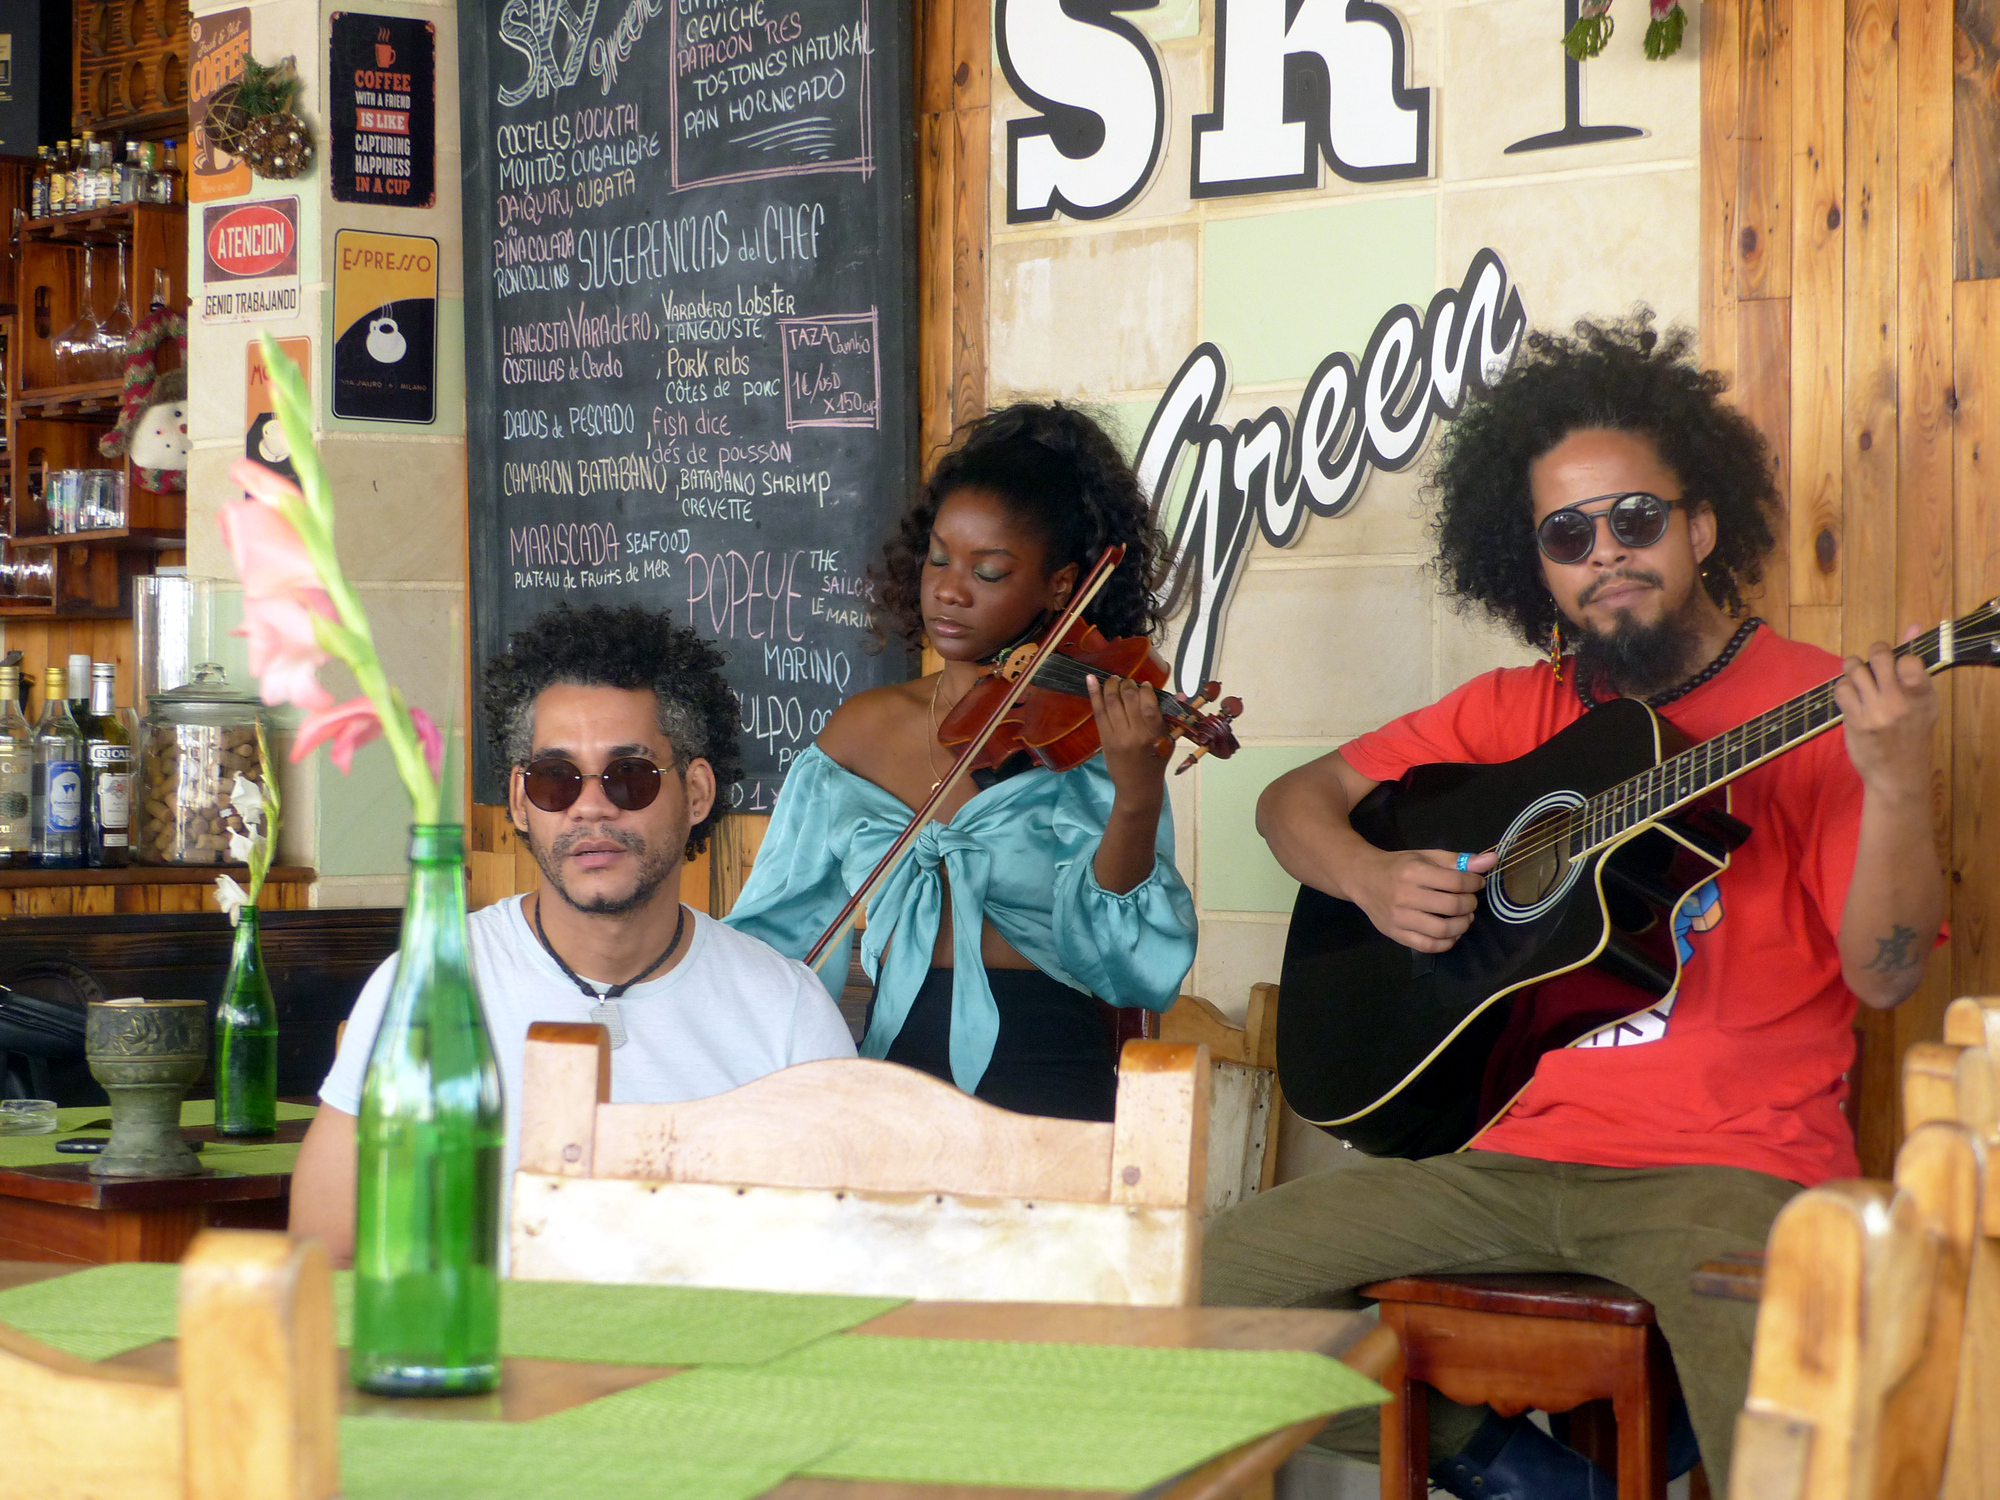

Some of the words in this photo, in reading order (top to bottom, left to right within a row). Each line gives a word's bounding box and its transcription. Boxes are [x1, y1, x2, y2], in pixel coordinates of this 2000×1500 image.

[686, 0, 768, 43] CEVICHE
[677, 30, 753, 77] PATACON
[764, 11, 803, 45] RES
[693, 49, 788, 101] TOSTONES
[792, 20, 875, 68] NATURAL
[354, 69, 411, 92] COFFEE
[355, 90, 376, 106] WITH
[377, 92, 383, 107] A
[385, 93, 411, 109] FRIEND
[683, 105, 720, 139] PAN
[728, 68, 846, 124] HORNEADO
[361, 112, 374, 128] IS
[376, 113, 405, 130] LIKE
[355, 133, 411, 156] CAPTURING
[355, 154, 411, 177] HAPPINESS
[355, 175, 370, 192] IN
[373, 177, 383, 193] A
[385, 178, 411, 195] CUP
[576, 168, 635, 209] CUBATA
[217, 221, 285, 260] ATENCION
[578, 210, 730, 292] SUGERENCIAS
[738, 226, 761, 261] del
[763, 203, 825, 265] CHEF
[342, 247, 432, 273] ESPRESSO
[205, 294, 233, 316] GENIO
[235, 288, 296, 314] TRABAJANDO
[503, 320, 570, 356] LANGOSTA
[666, 317, 763, 344] LANGOUSTE
[788, 324, 832, 351] TAZA
[502, 357, 565, 385] COSTILLAS
[569, 356, 580, 381] de
[581, 350, 623, 380] Cerdo
[713, 376, 730, 399] de
[503, 409, 549, 440] DADOS
[552, 414, 565, 439] de
[569, 403, 635, 437] PESCADO
[653, 406, 688, 437] Fish
[687, 442, 708, 465] de
[503, 459, 574, 496] CAMARON
[680, 467, 755, 496] BATABANO
[1128, 246, 1527, 700] Green
[682, 496, 753, 522] CREVETTE
[510, 522, 621, 568] MARISCADA
[626, 528, 691, 555] SEAFOOD
[810, 549, 840, 572] THE
[514, 570, 560, 589] PLATEAU
[563, 569, 577, 591] de
[625, 561, 640, 583] de
[685, 550, 805, 642] POPEYE
[811, 596, 826, 615] LE
[731, 689, 804, 756] ULPO
